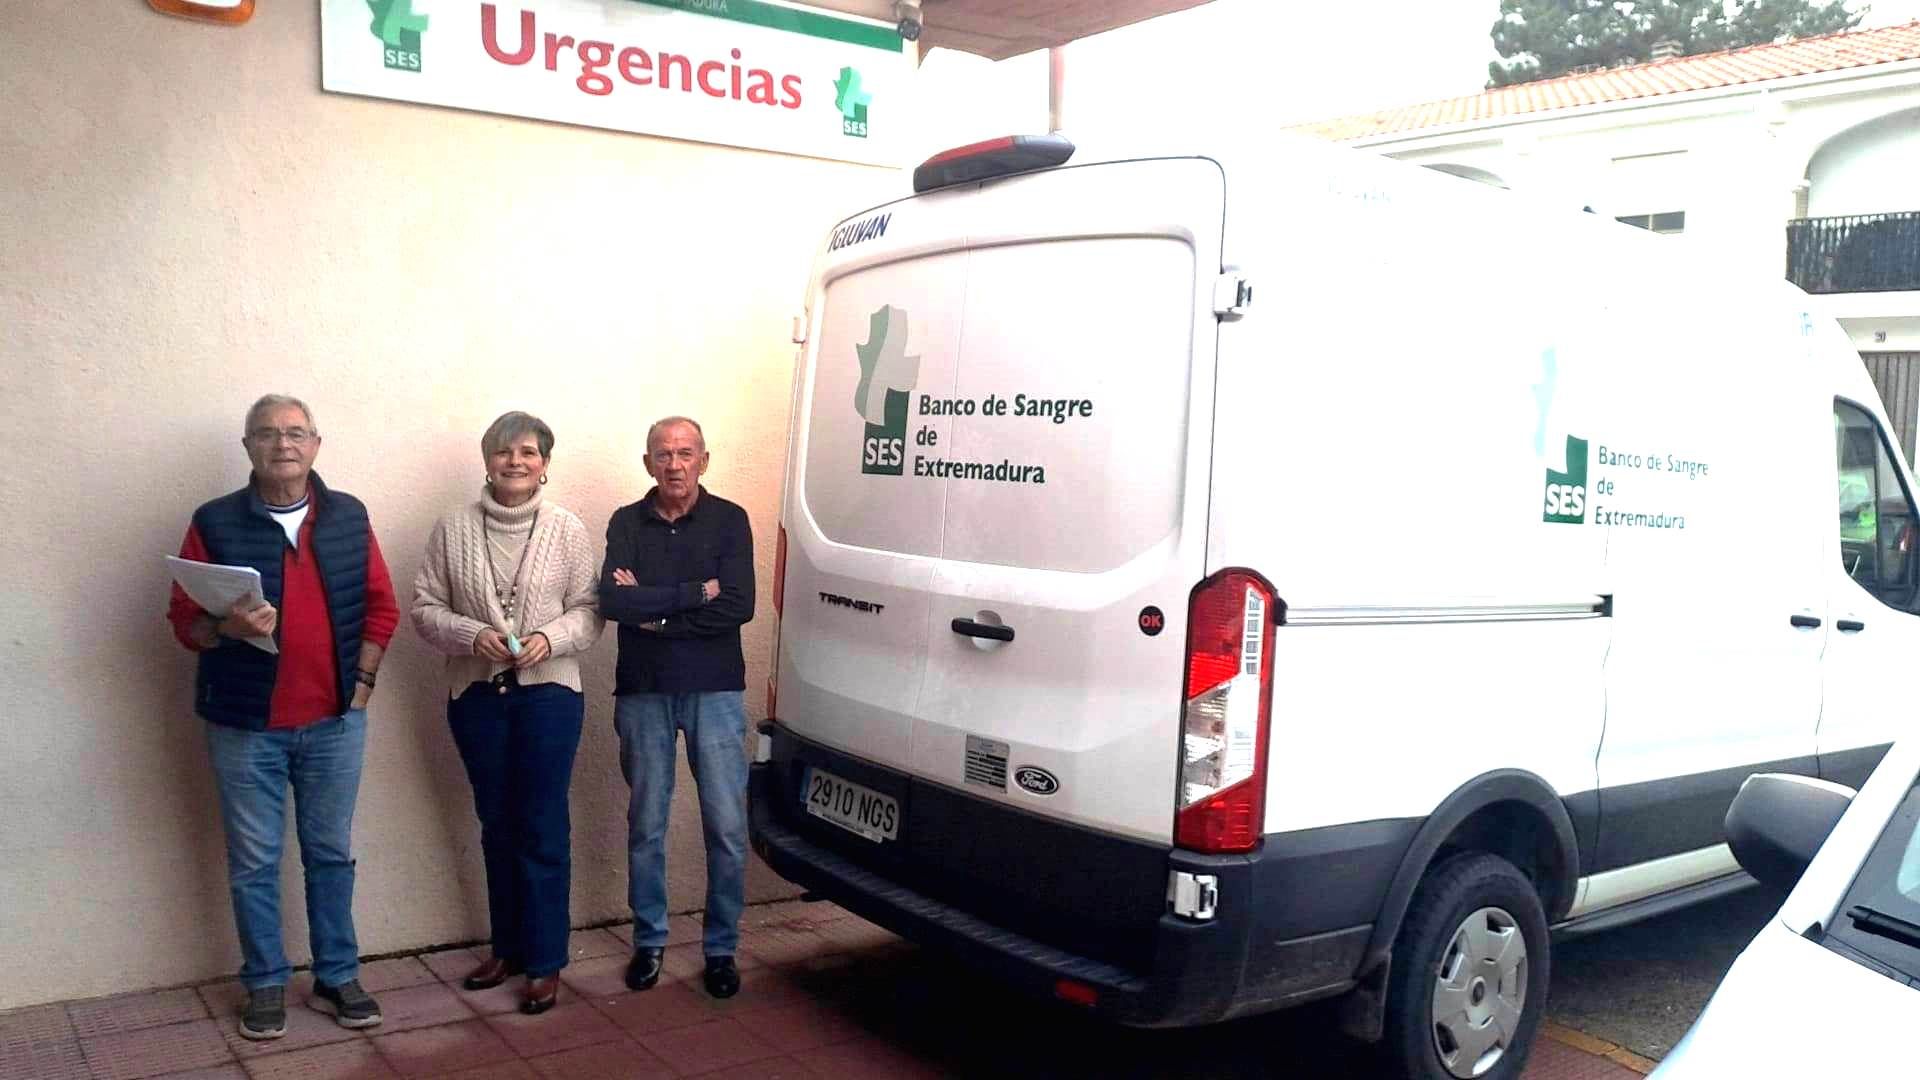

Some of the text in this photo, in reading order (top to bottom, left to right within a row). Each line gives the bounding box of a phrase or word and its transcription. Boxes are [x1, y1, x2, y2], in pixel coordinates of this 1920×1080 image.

[385, 49, 420, 68] SES
[481, 3, 801, 109] Urgencias
[844, 120, 867, 136] SES
[827, 212, 892, 253] IGLUVAN
[919, 393, 1093, 425] Banco de Sangre
[915, 425, 938, 447] de
[864, 437, 903, 466] SES
[1598, 445, 1709, 480] Banco de Sangre
[913, 455, 1046, 484] Extremadura
[1596, 476, 1615, 496] de
[1545, 483, 1585, 516] SES
[1594, 505, 1686, 529] Extremadura
[819, 592, 885, 614] TRANSIT
[1141, 614, 1161, 628] OK
[1020, 771, 1049, 790] Ford
[810, 775, 854, 815] 2910
[858, 793, 895, 832] NGS
